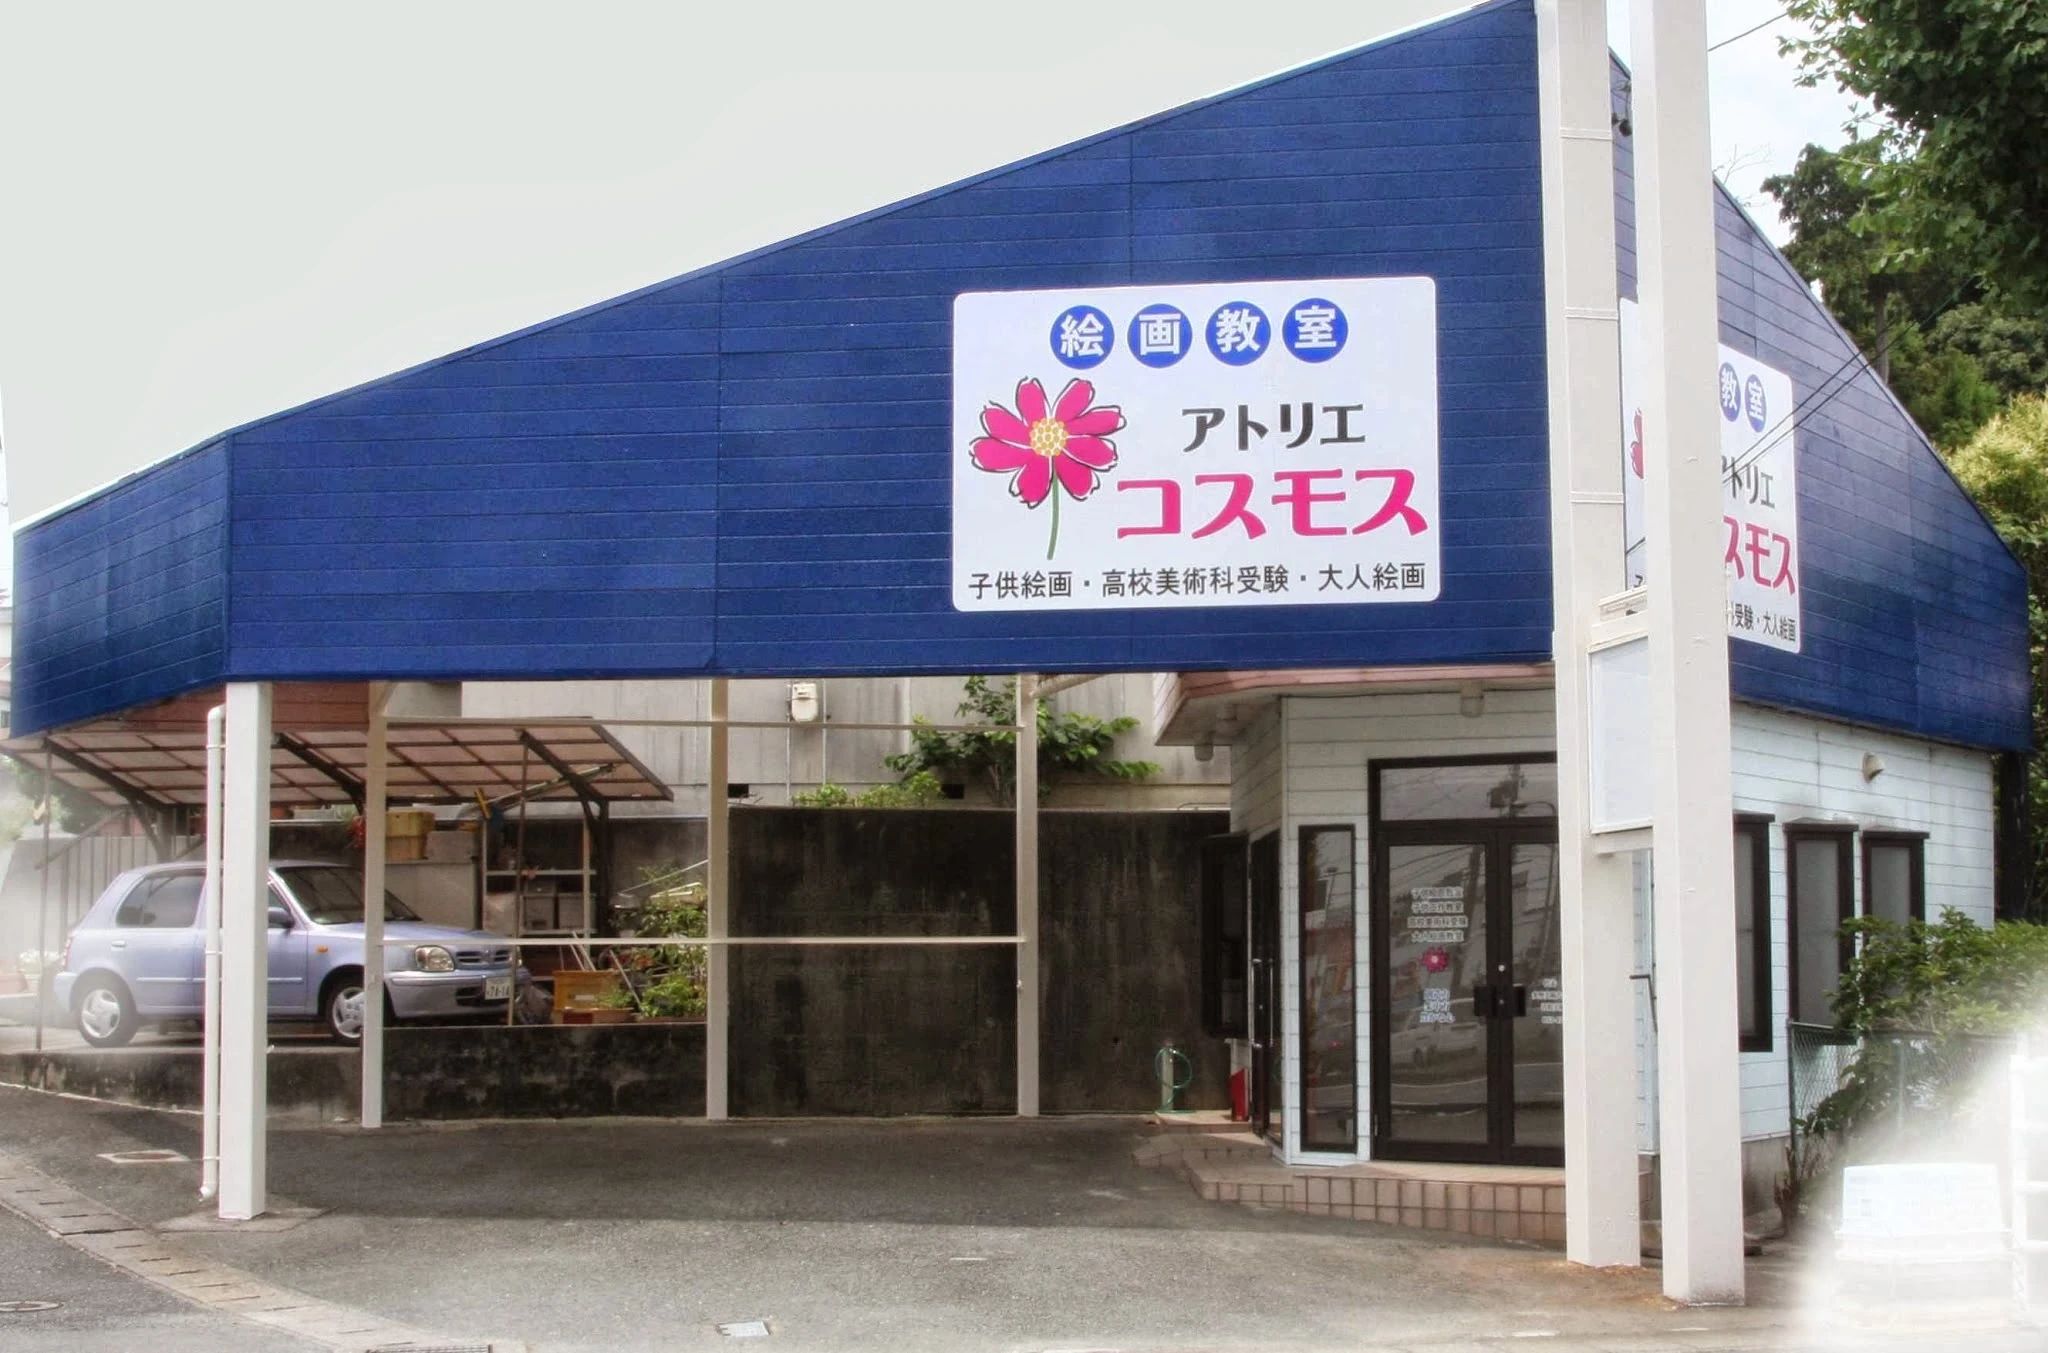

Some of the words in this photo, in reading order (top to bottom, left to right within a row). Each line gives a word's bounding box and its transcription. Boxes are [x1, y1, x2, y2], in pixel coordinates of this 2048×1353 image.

[1059, 305, 1337, 358] 絵画教室
[1181, 402, 1366, 452] アトリエ
[1116, 468, 1429, 540] コスモス
